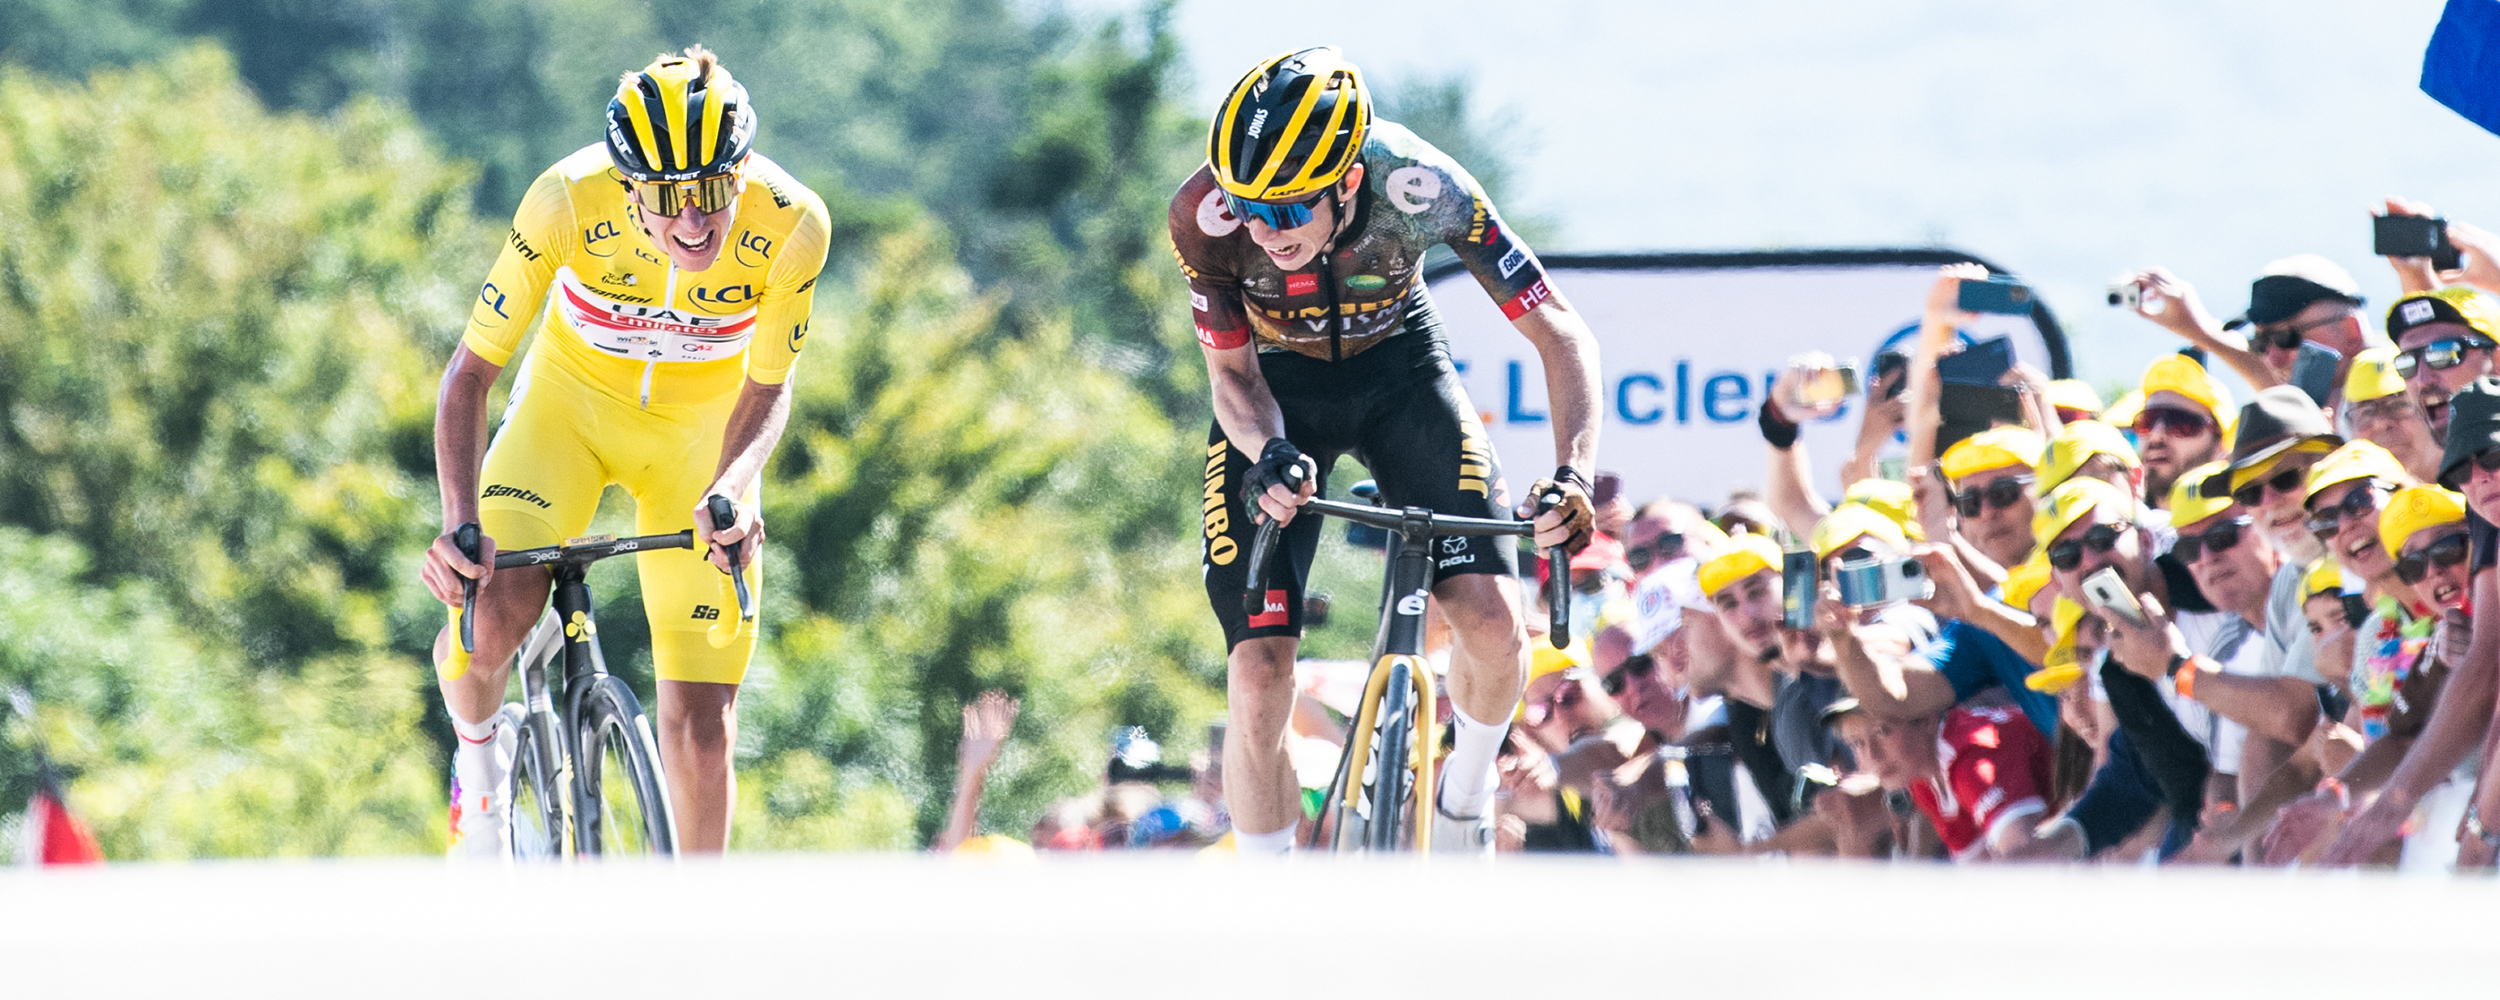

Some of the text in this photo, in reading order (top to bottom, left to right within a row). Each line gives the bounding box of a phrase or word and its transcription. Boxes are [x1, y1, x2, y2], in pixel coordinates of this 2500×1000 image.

[606, 109, 633, 154] MET
[1247, 108, 1269, 139] JONAS
[664, 171, 700, 181] MET
[585, 220, 620, 245] LCL
[635, 248, 663, 266] LCL
[740, 230, 773, 260] LCL
[1503, 248, 1527, 272] GOR
[697, 284, 764, 304] LCL
[1289, 280, 1316, 289] HEMA
[481, 283, 509, 320] CL
[610, 312, 718, 334] Emirates
[612, 304, 722, 328] UAE
[480, 484, 552, 509] Santini
[1203, 440, 1238, 566] JUMBO
[1439, 554, 1475, 569] AGU
